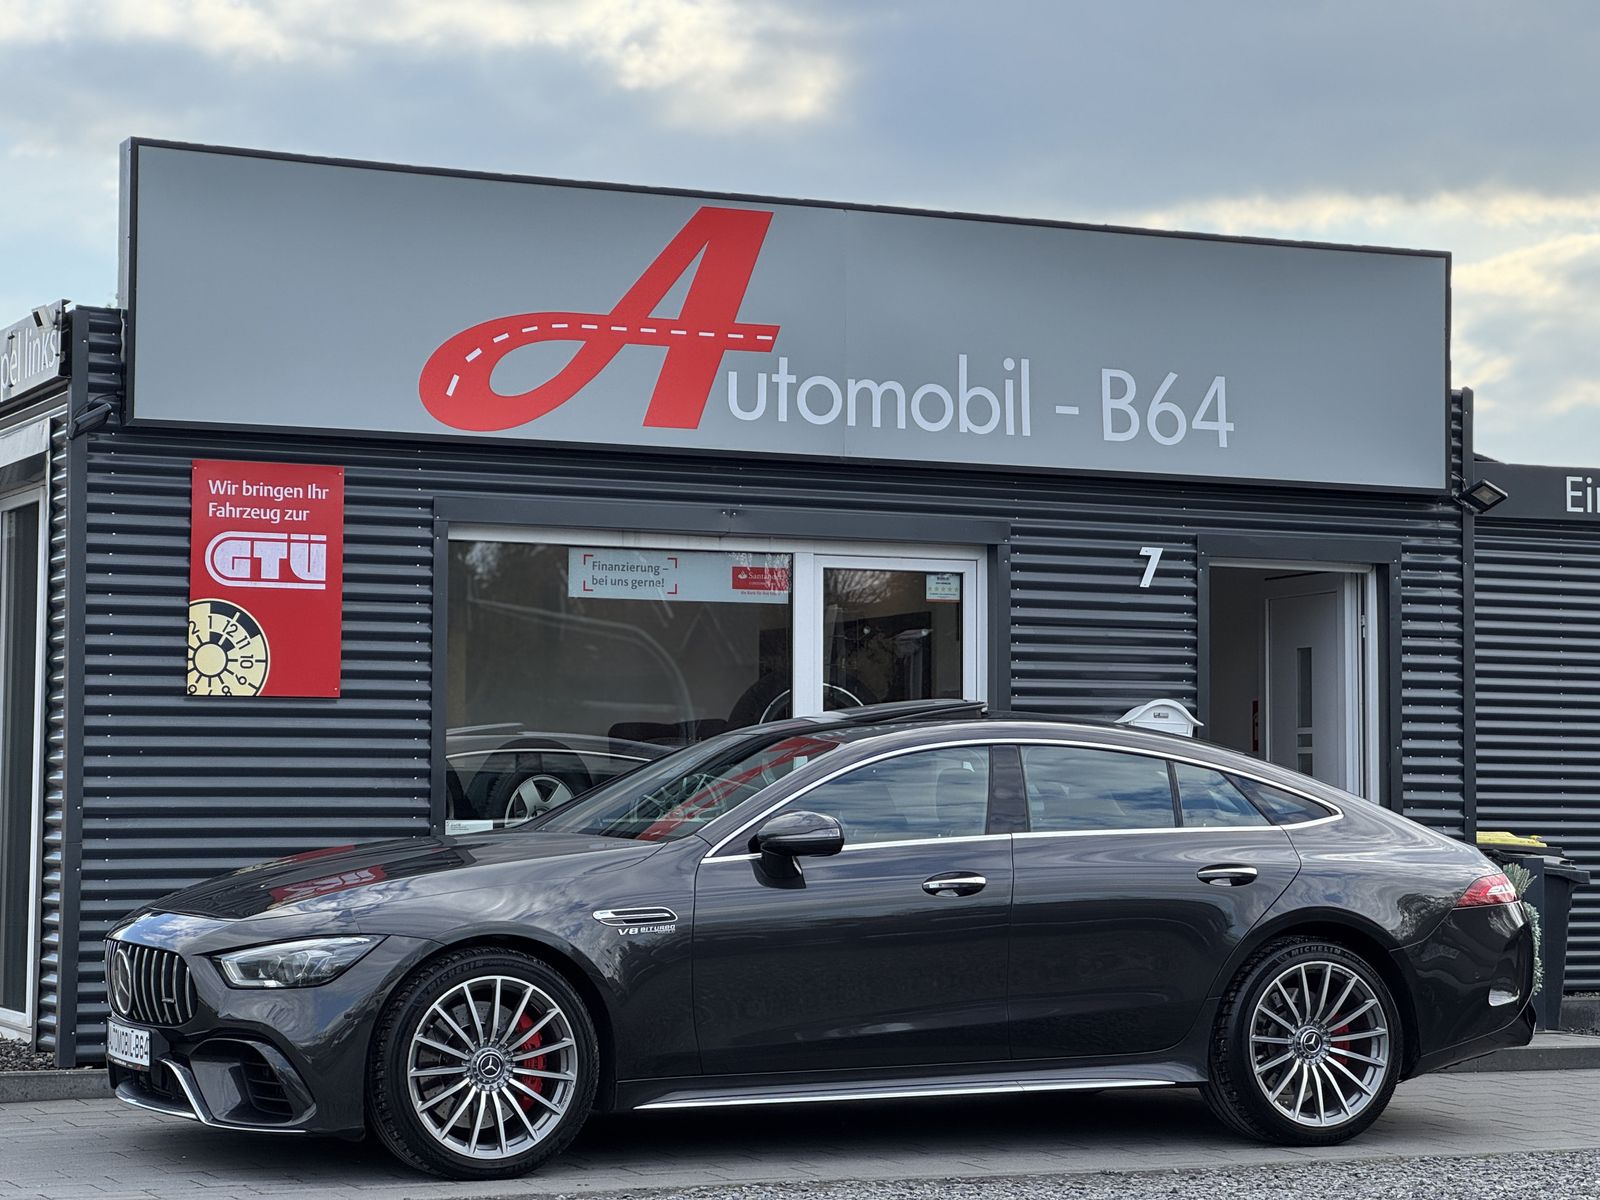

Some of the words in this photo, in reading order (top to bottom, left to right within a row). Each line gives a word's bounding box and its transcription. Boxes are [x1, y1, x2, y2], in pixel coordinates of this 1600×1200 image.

[1055, 405, 1079, 415] -
[1101, 367, 1235, 448] B64
[208, 479, 239, 496] Wir
[242, 480, 303, 502] bringen
[307, 483, 329, 500] Ihr
[208, 502, 281, 524] Fahrzeug
[284, 509, 310, 521] zur
[206, 532, 327, 588] GTÜ
[592, 560, 660, 576] Finanzierung
[1139, 547, 1164, 588] 7
[591, 575, 608, 587] bei
[611, 578, 629, 587] uns
[631, 577, 665, 589] gerne!
[208, 615, 213, 630] 1
[222, 619, 239, 638] 12
[236, 635, 251, 650] 11
[240, 654, 254, 669] 10
[617, 927, 639, 936] V8
[1291, 945, 1341, 957] MICHELIN
